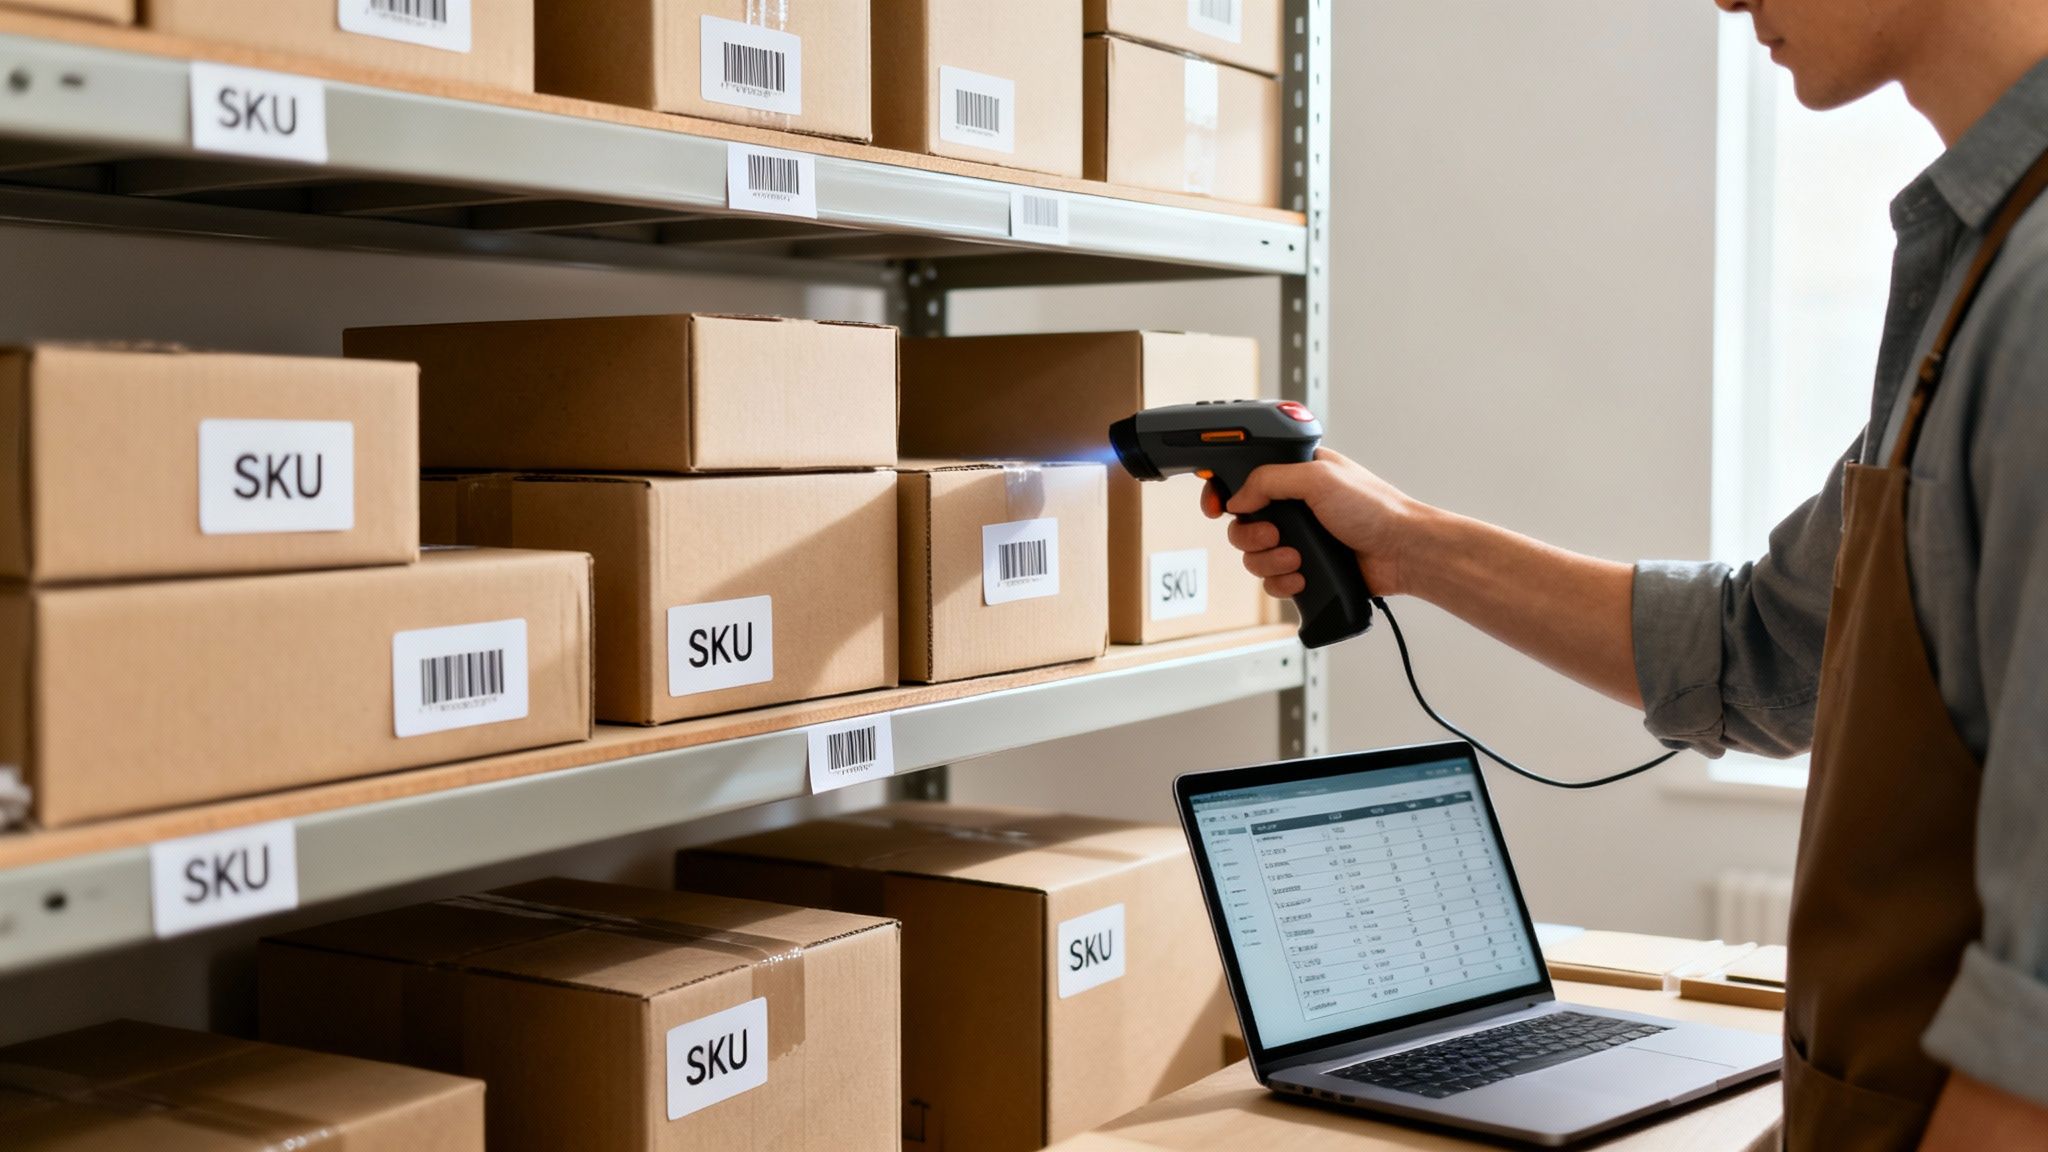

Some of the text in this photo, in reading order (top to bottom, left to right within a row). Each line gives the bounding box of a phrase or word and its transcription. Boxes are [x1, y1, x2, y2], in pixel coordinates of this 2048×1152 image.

[218, 87, 297, 136] SKU
[233, 453, 323, 500] SKU
[1162, 572, 1197, 602] SKU
[688, 621, 753, 669] SKU
[184, 843, 271, 903] SKU
[1069, 930, 1112, 972] SKU
[685, 1028, 748, 1086] SKU
